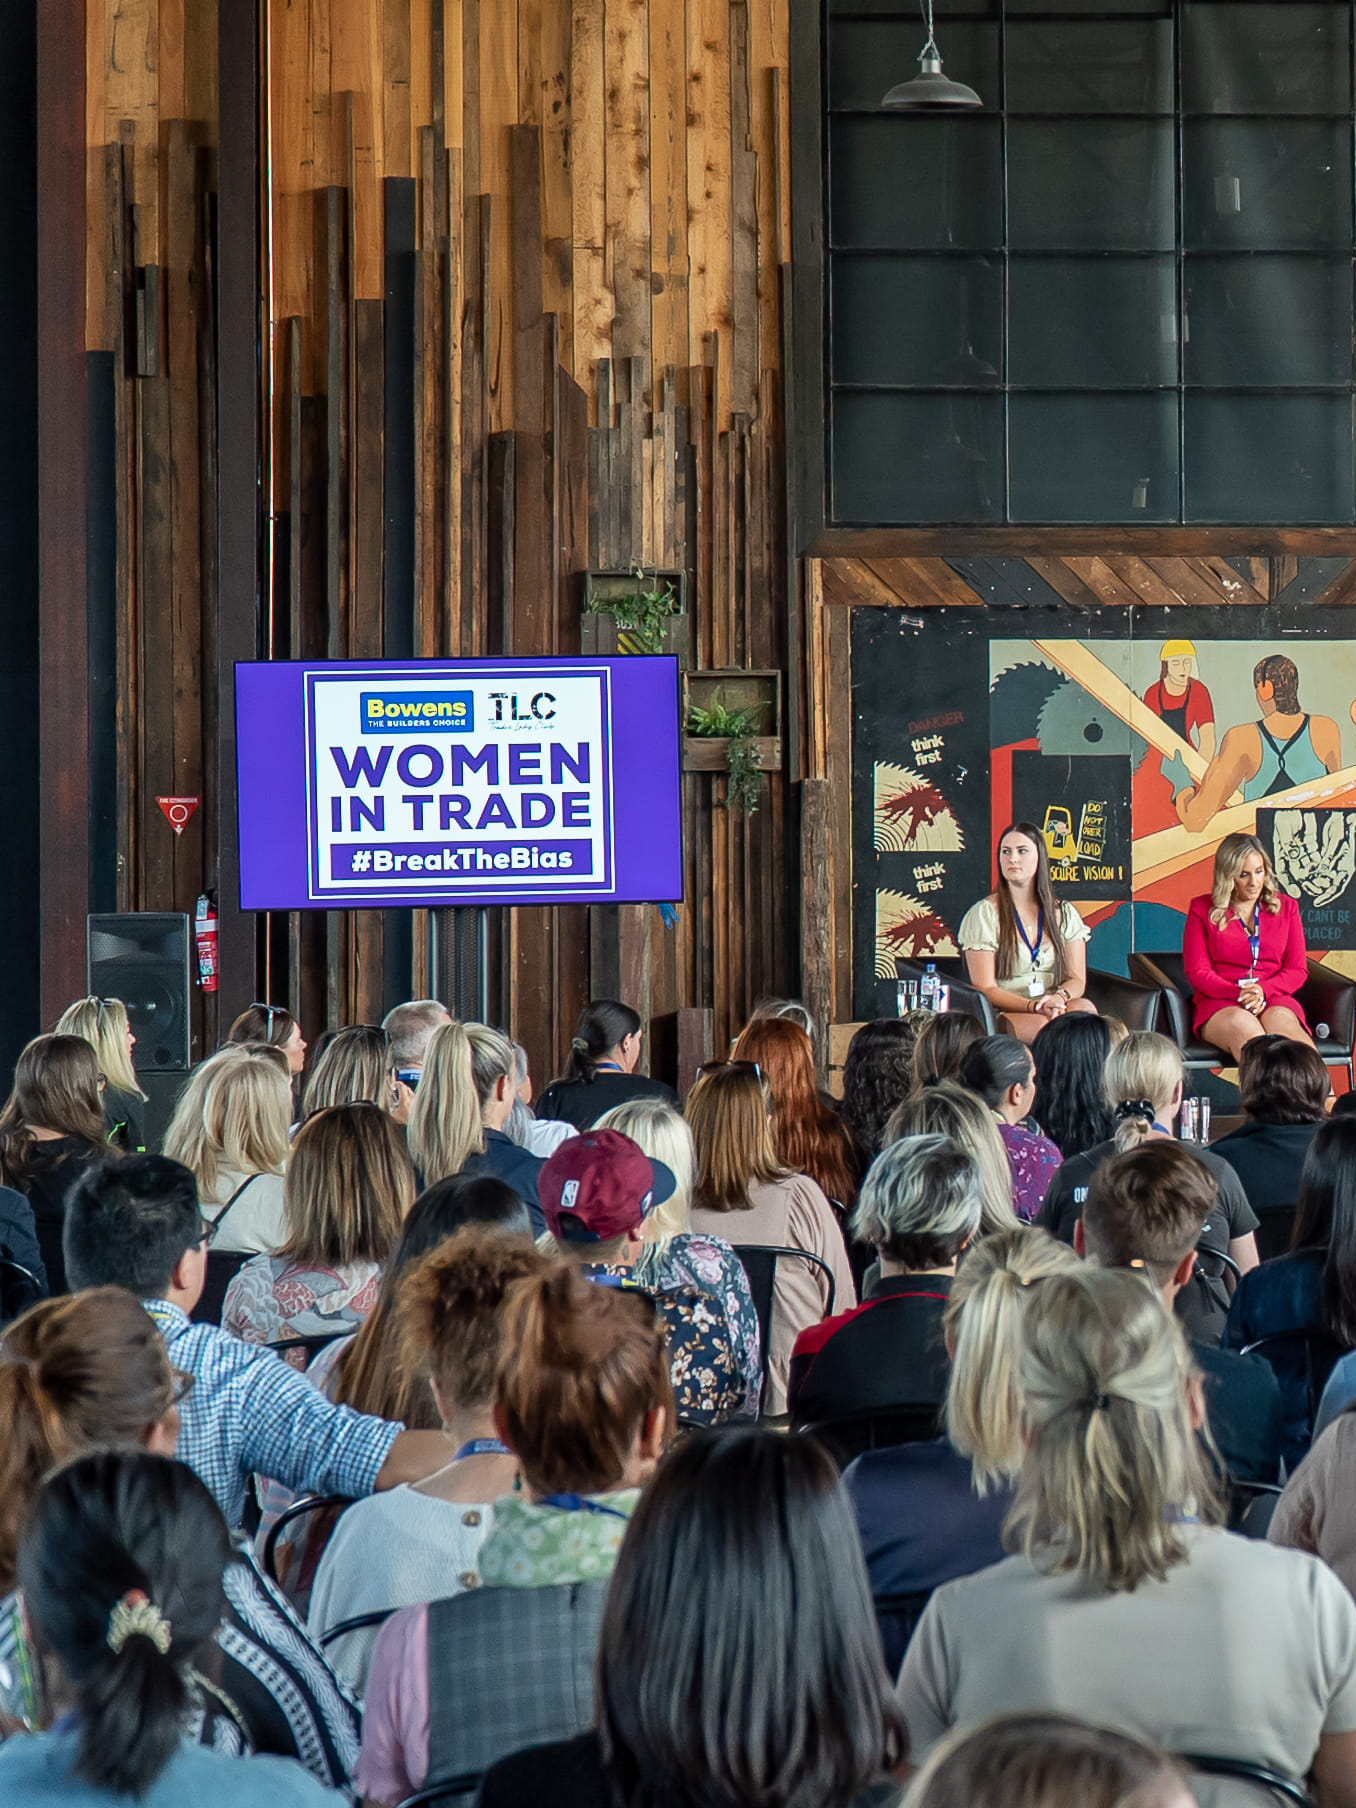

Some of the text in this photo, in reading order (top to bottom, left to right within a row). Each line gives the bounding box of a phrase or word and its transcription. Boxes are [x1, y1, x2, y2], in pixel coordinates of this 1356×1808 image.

[367, 699, 467, 717] Bowens
[488, 692, 557, 720] TLC
[433, 718, 466, 726] CHOICE
[908, 711, 964, 734] DANGER
[911, 735, 945, 752] think
[329, 742, 591, 788] WOMEN
[915, 749, 942, 766] first
[330, 791, 592, 833] IN TRADE
[1087, 803, 1101, 812] DO
[1084, 815, 1103, 825] NOT
[1080, 840, 1101, 856] LOAD
[351, 846, 573, 873] #BreakTheBias
[913, 862, 946, 879] think
[1083, 865, 1113, 880] VISION
[916, 876, 943, 893] first
[1337, 910, 1350, 924] BE
